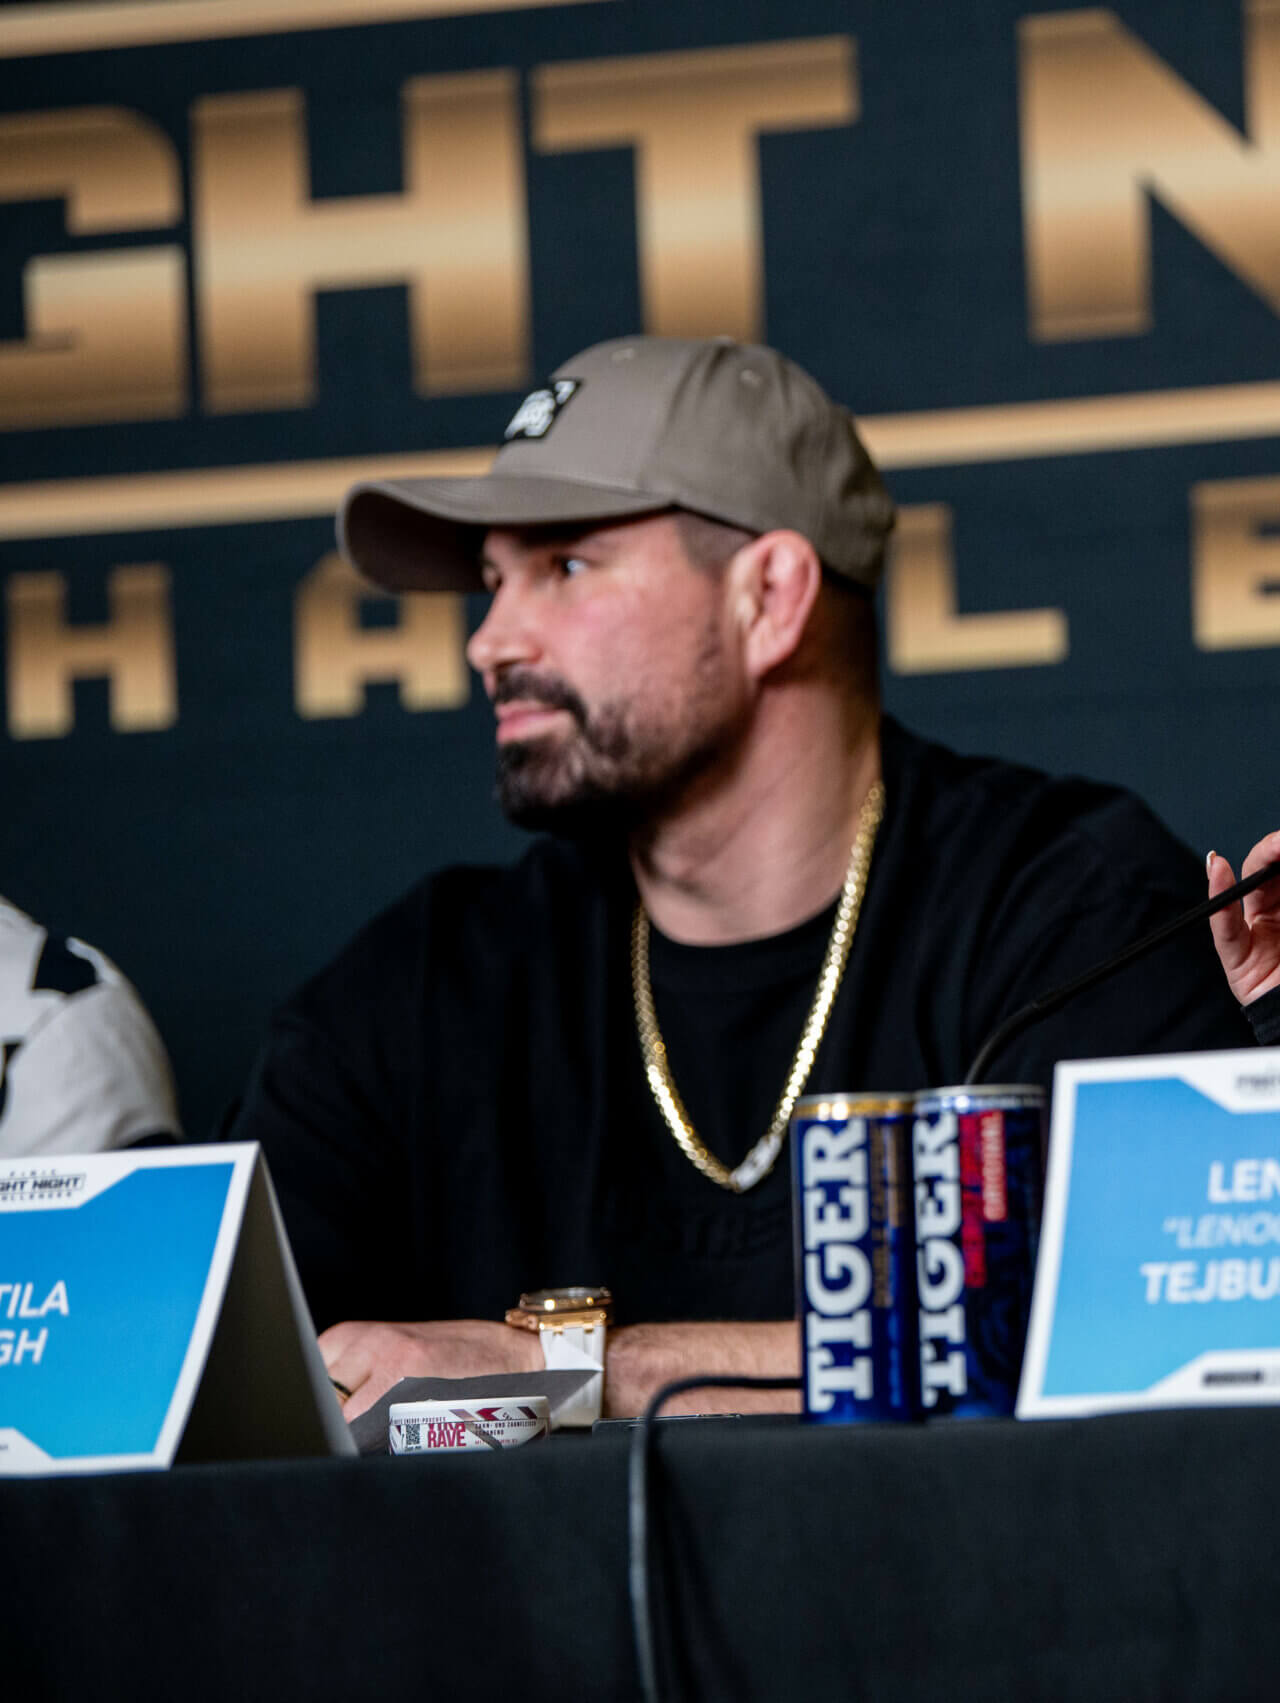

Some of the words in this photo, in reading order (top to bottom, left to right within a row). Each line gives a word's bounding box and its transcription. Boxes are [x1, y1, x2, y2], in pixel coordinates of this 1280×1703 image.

[802, 1117, 874, 1413] TIGER
[912, 1109, 968, 1408] TIGER
[428, 1430, 467, 1449] RAVE
